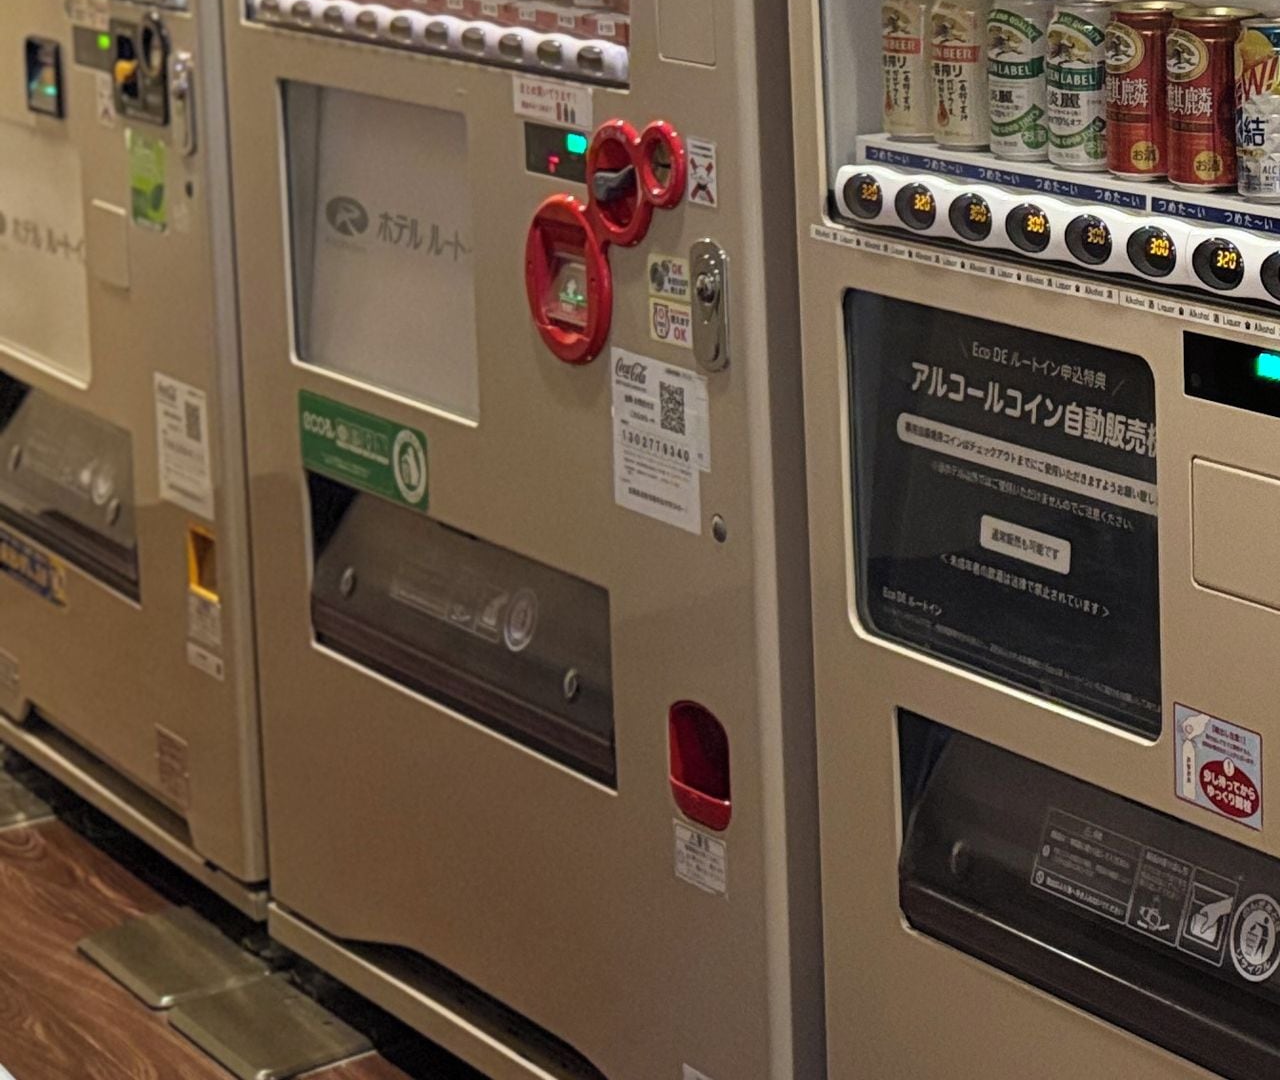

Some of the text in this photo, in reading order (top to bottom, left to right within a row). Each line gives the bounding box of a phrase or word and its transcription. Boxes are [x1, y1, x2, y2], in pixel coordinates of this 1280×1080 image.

[377, 211, 423, 250] ホテル
[671, 262, 683, 276] OK
[673, 325, 688, 341] OK
[972, 341, 991, 360] Eco
[993, 346, 1009, 364] DE
